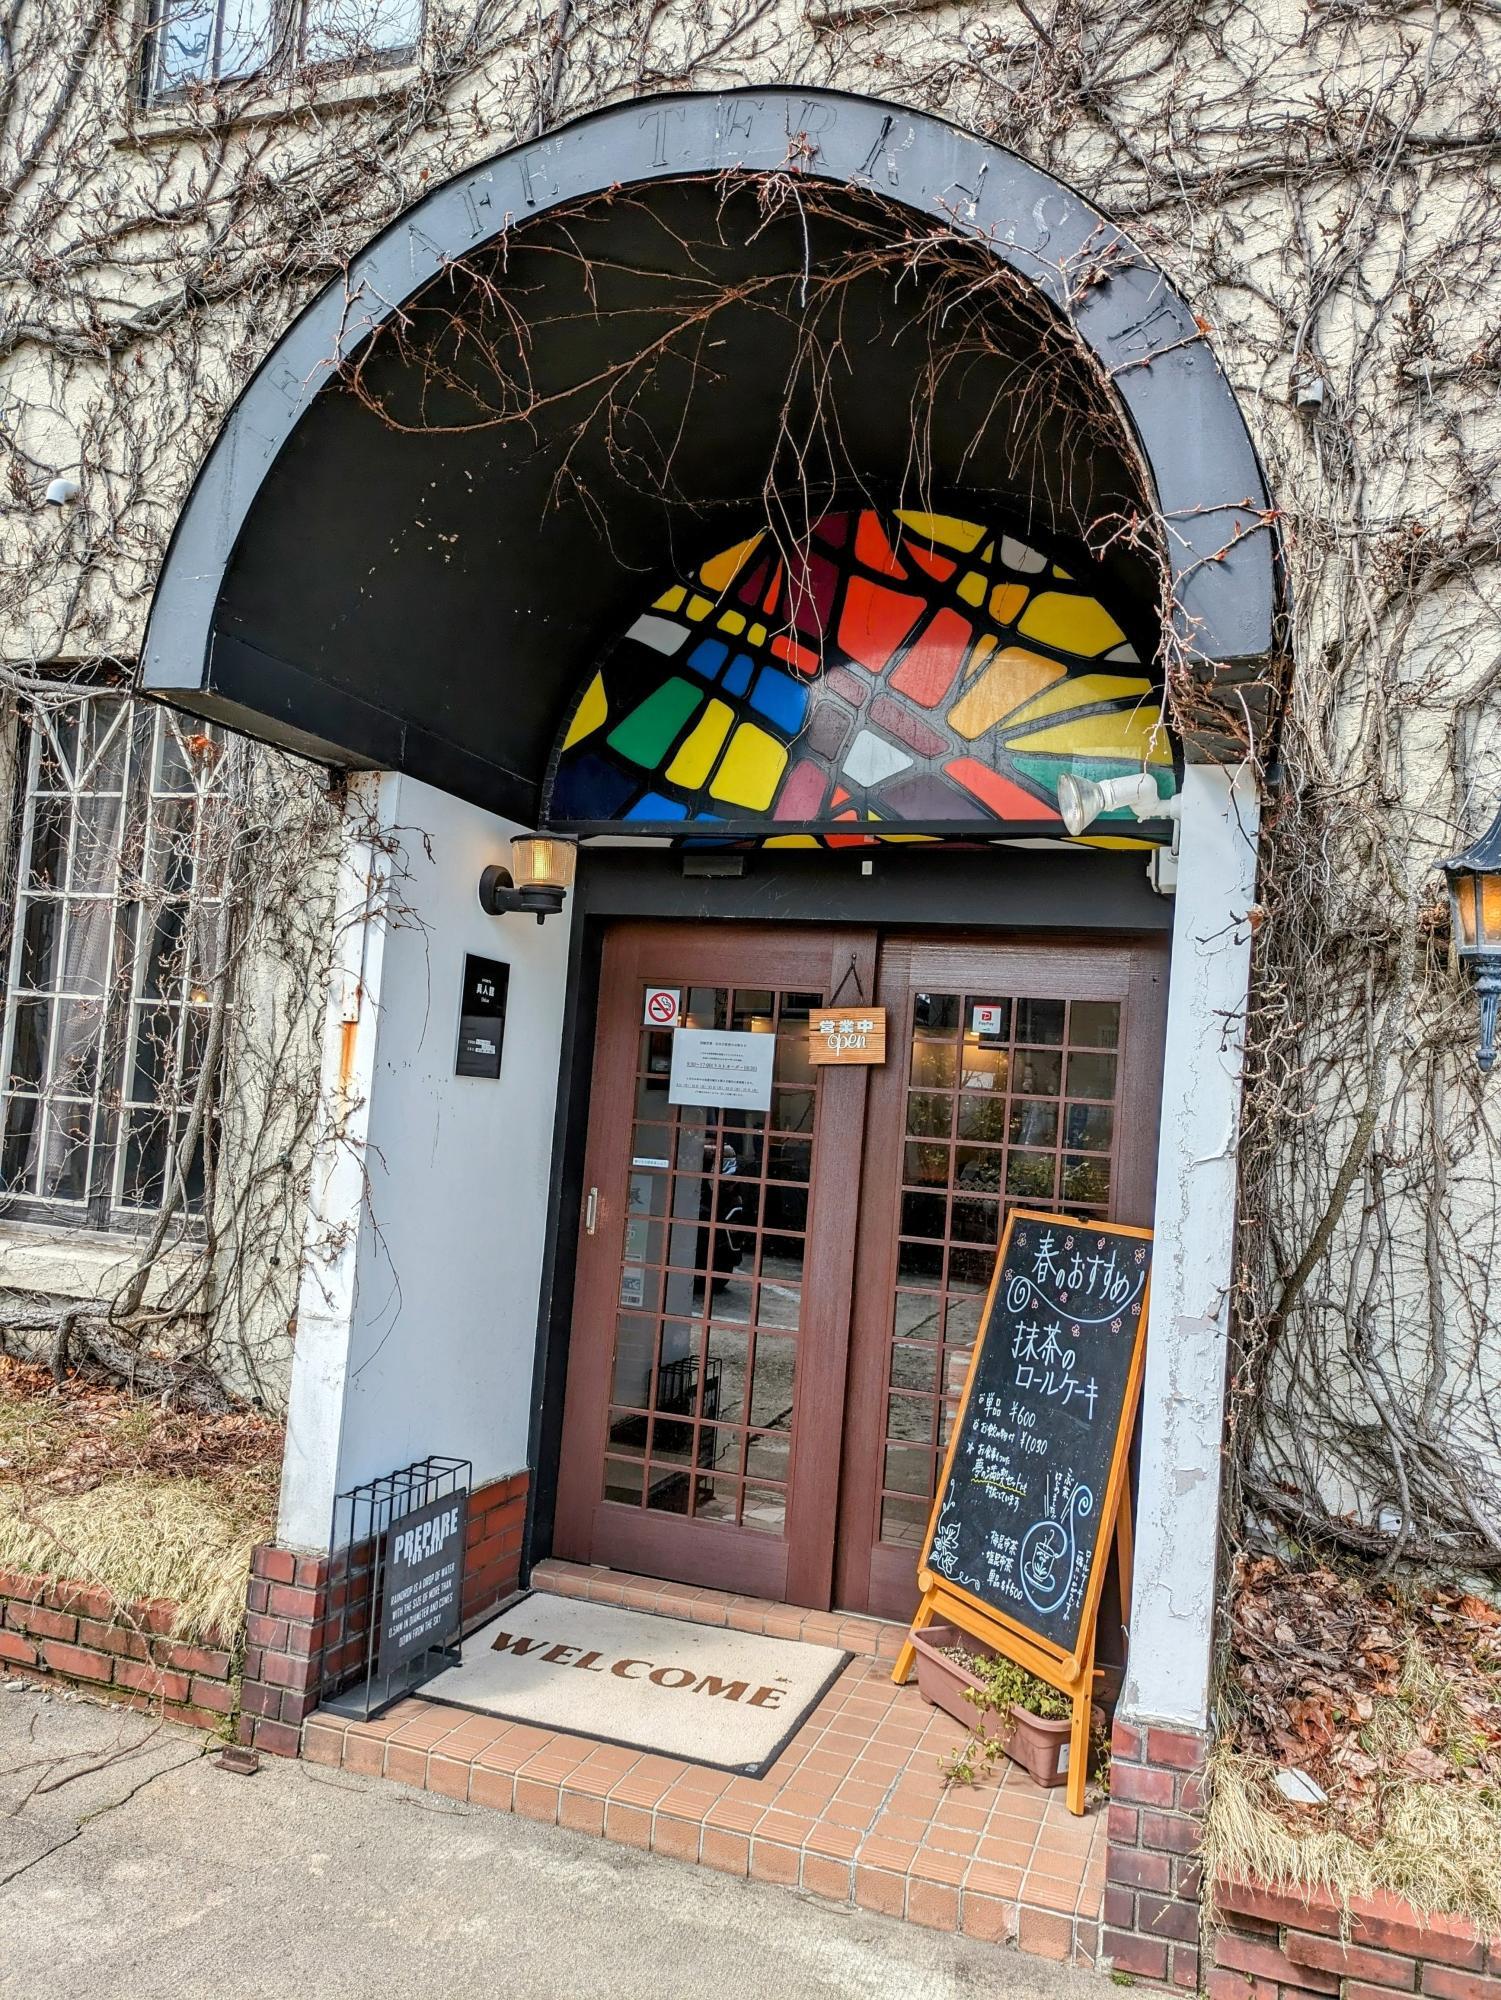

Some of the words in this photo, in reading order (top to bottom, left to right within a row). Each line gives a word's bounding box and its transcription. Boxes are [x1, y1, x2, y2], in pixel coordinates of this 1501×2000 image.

[819, 1019, 874, 1034] 営業中
[1032, 1229, 1130, 1304] 春のおすすめ
[1012, 1320, 1076, 1371] 抹茶の
[984, 1392, 1002, 1417] 単品
[1009, 1401, 1036, 1428] ¥600
[1015, 1365, 1099, 1420] ロールケーキ
[1019, 1431, 1048, 1456] ¥1,030
[393, 1507, 459, 1565] PREPARE
[407, 1547, 422, 1567] FOR
[424, 1538, 444, 1559] RAIN
[390, 1585, 413, 1606] RAINDROP
[413, 1581, 418, 1594] IS
[422, 1573, 435, 1589] DROP
[435, 1570, 441, 1582] OF
[441, 1562, 455, 1578] WATER
[392, 1606, 403, 1621] WITH
[404, 1602, 412, 1616] THE
[412, 1596, 422, 1611] SIZE
[422, 1592, 428, 1605] OF
[428, 1586, 440, 1602] MORE
[440, 1578, 452, 1595] THAN
[398, 1630, 412, 1648] DOWN
[412, 1625, 424, 1641] FROM
[424, 1619, 433, 1633] THE
[433, 1613, 442, 1628] SKY
[403, 1618, 409, 1630] IN
[409, 1607, 429, 1628] DIAMETER
[429, 1602, 438, 1615] AND
[439, 1592, 454, 1610] COMES
[490, 1631, 787, 1710] WELCOME
